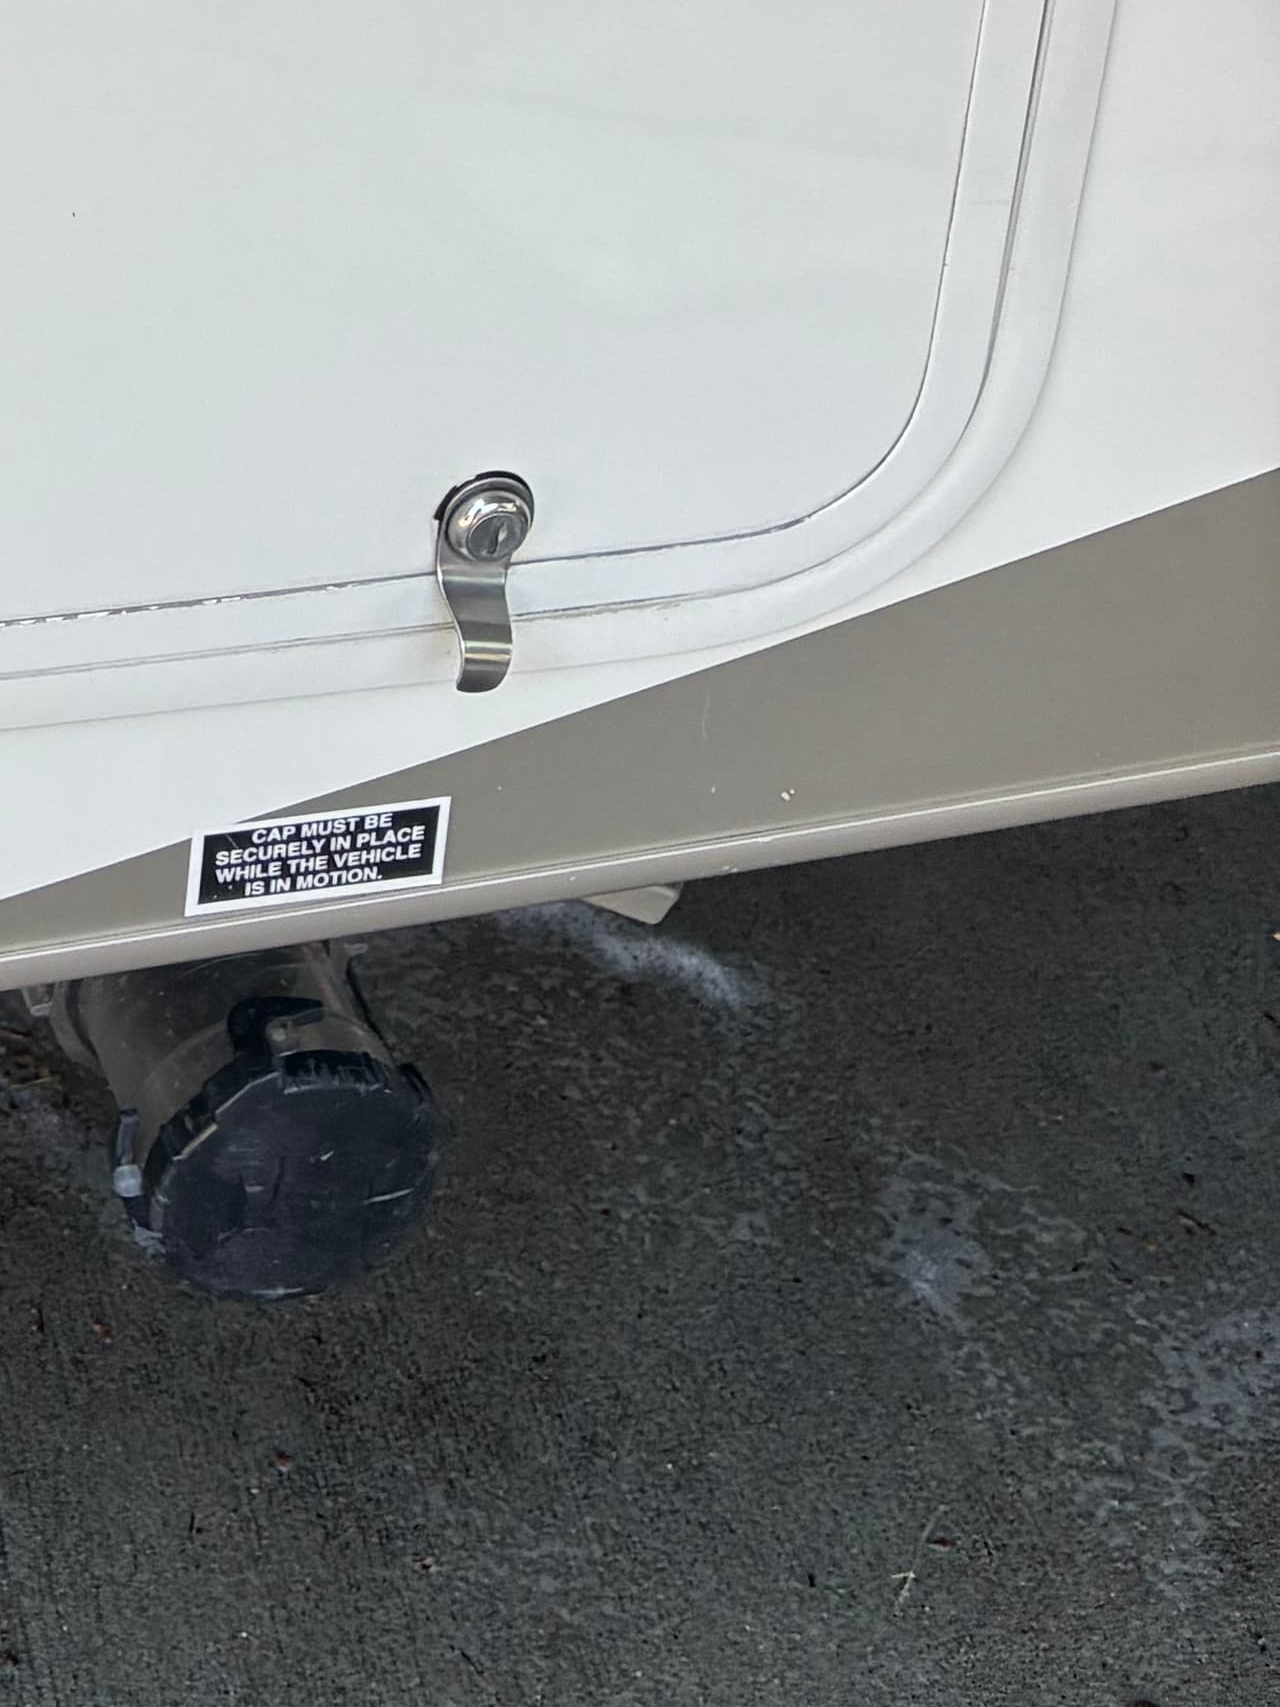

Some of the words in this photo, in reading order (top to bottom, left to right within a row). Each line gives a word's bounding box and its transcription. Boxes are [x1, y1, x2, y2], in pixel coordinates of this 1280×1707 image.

[215, 839, 326, 866] SECURELY
[330, 835, 351, 851] IN
[356, 825, 425, 848] PLACE
[252, 826, 296, 844] CAP
[301, 817, 360, 838] MUST
[364, 813, 393, 829] BE
[215, 860, 282, 884] WHILE
[287, 855, 328, 874] THE
[334, 843, 422, 868] VEHICLE
[245, 881, 265, 896] IS
[270, 877, 291, 893] IN
[296, 867, 383, 890] MOTION.
